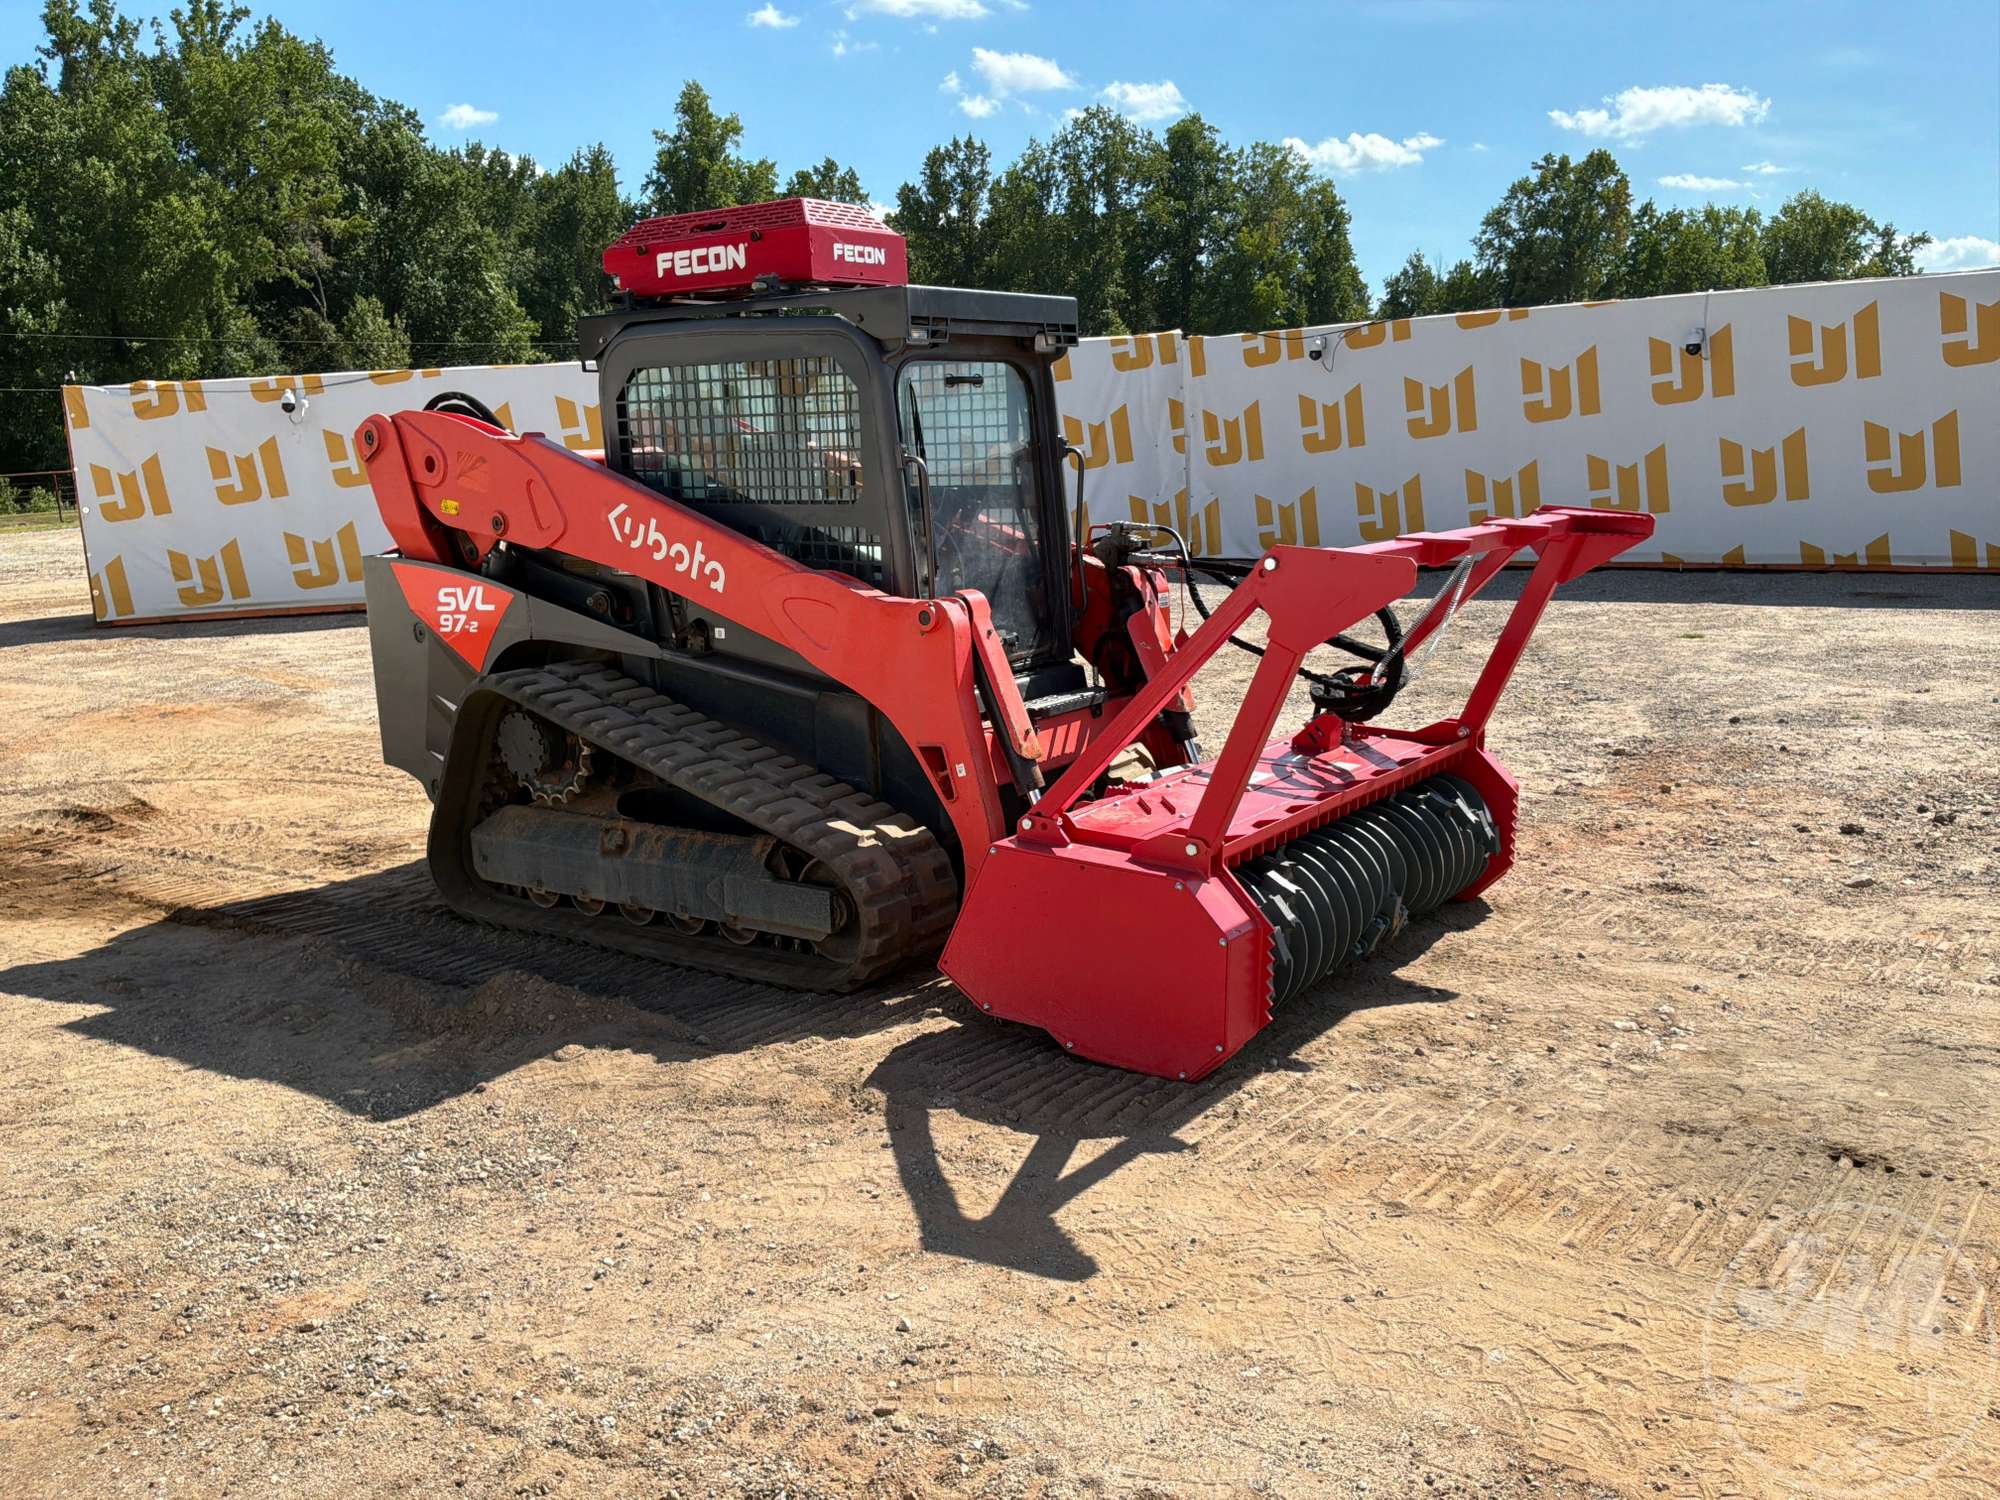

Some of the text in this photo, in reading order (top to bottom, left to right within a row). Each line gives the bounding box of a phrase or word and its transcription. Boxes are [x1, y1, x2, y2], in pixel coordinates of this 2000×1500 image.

[656, 243, 747, 278] FECON
[833, 242, 886, 266] FECON
[607, 503, 725, 593] Kubota
[436, 585, 496, 612] SVL
[439, 614, 478, 633] 97-2
